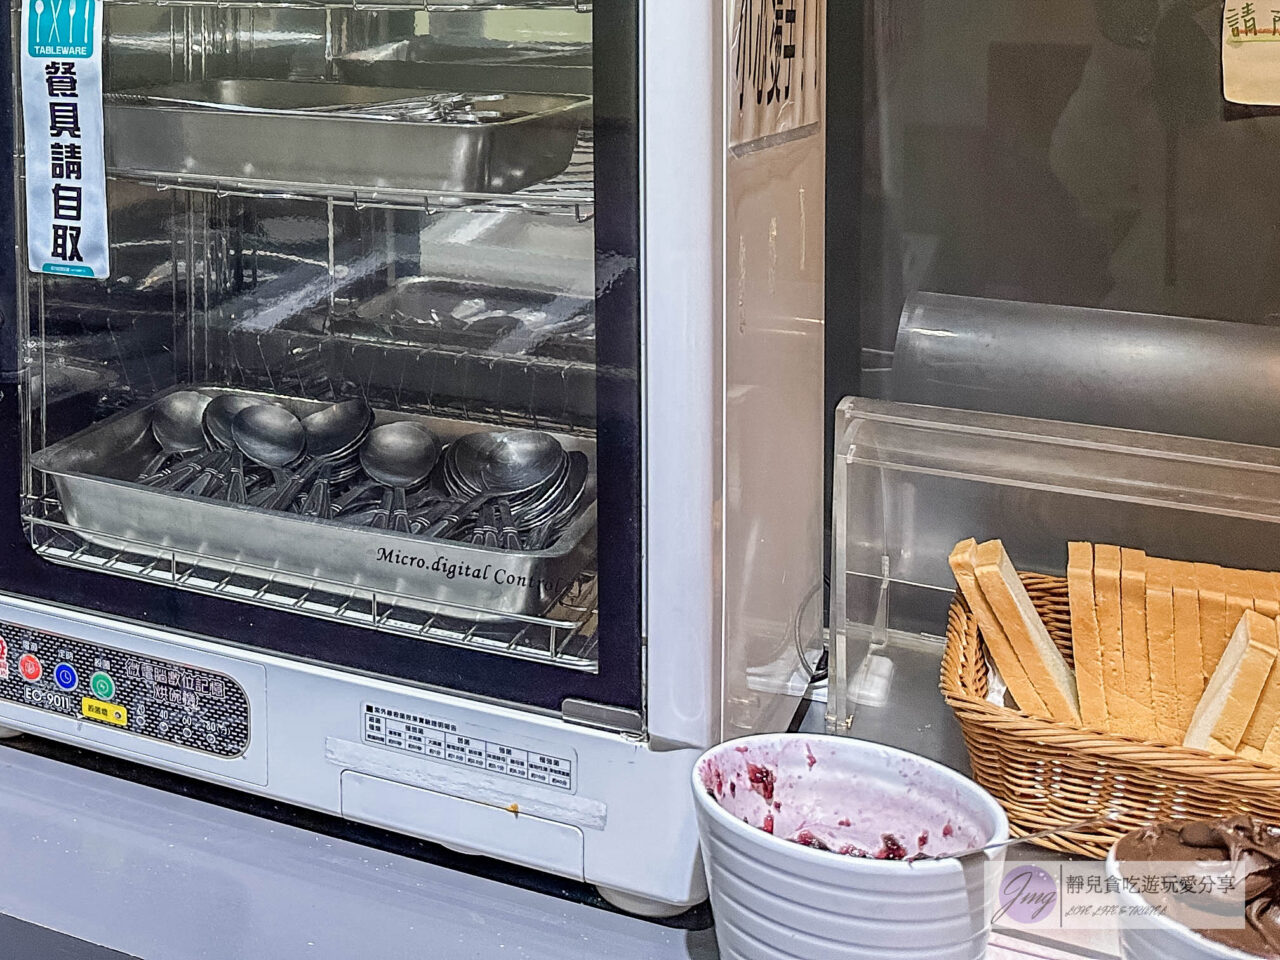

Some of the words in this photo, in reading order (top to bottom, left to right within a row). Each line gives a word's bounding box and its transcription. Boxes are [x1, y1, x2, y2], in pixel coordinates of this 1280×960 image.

[33, 45, 87, 56] TABLEWARE
[44, 60, 84, 262] 餐具請自取
[377, 547, 492, 580] Micro.digital
